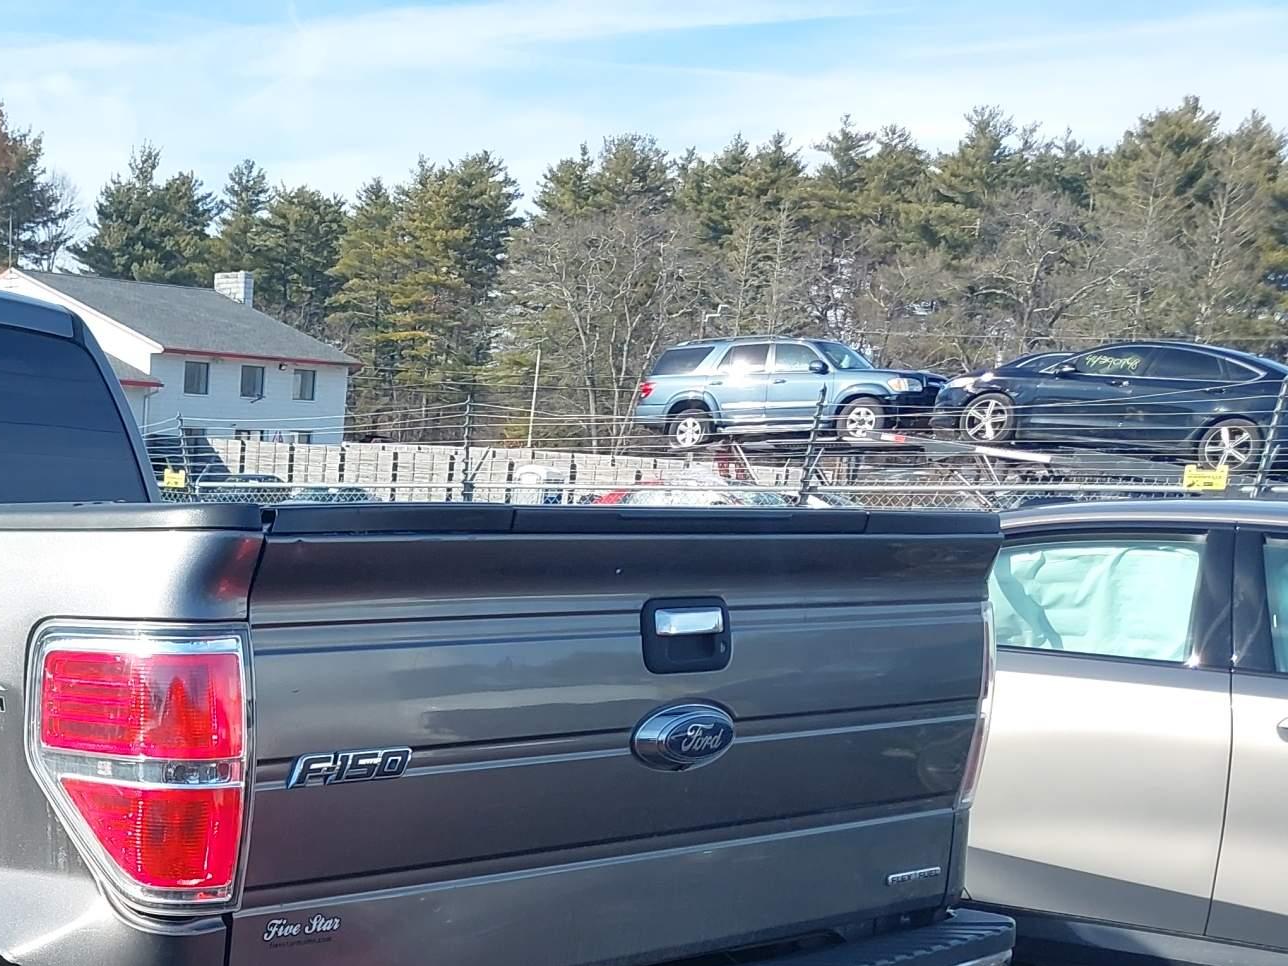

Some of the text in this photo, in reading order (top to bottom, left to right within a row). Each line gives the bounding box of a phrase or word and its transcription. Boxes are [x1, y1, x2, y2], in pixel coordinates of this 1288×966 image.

[674, 723, 724, 752] Ford
[288, 746, 412, 789] F-150
[263, 914, 341, 941] Five Star
